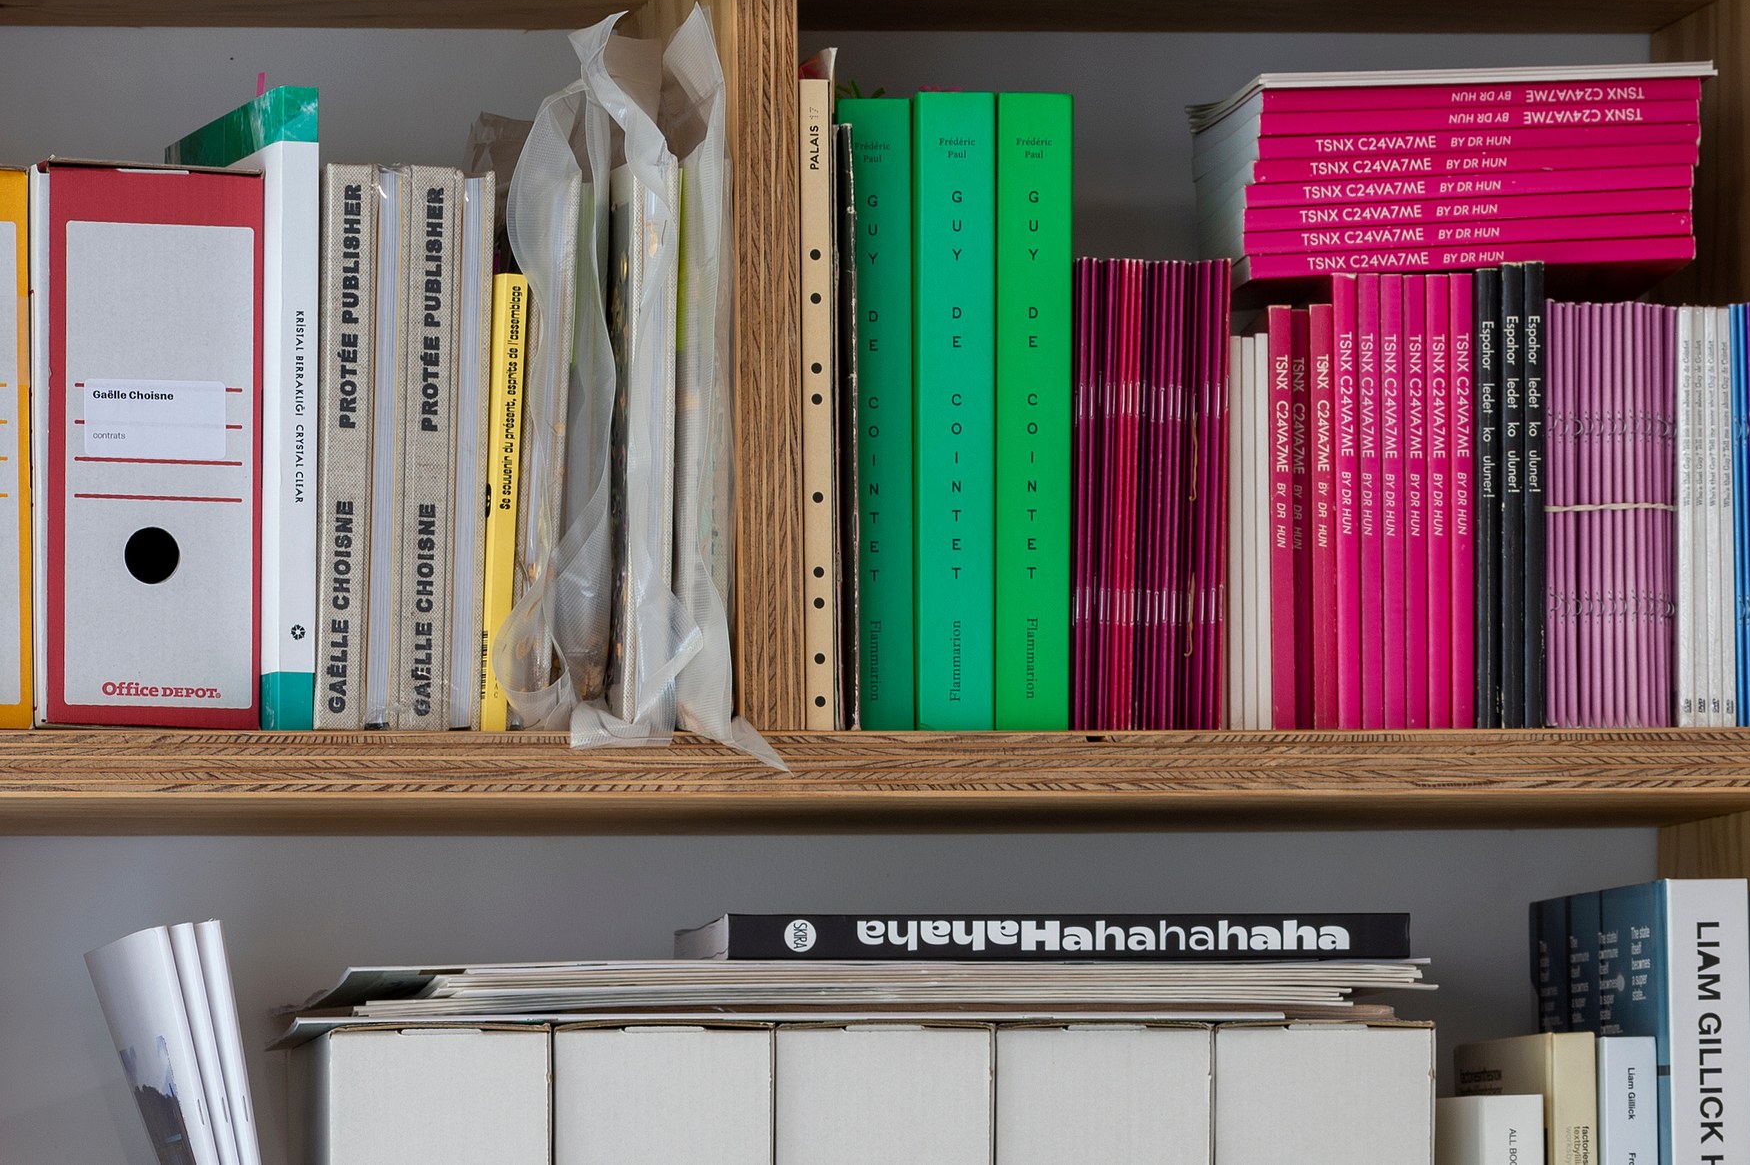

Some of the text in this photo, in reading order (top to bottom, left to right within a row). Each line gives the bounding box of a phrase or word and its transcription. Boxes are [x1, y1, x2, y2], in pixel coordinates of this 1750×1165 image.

[808, 124, 820, 171] PALAIS
[938, 137, 976, 147] Frédéric
[947, 150, 967, 159] Paul
[1315, 137, 1353, 152] TSNX
[1449, 137, 1467, 147] BY
[1468, 137, 1485, 146] DR
[1487, 134, 1511, 145] HUN
[337, 183, 362, 429] PROTÉE PUBLISHER
[1456, 332, 1469, 373] TSNX
[92, 388, 175, 401] Gaëlle Choisne
[1526, 315, 1541, 494] Espahor ledet ko uluner!
[92, 430, 126, 440] contrats
[294, 423, 305, 504] CRYSTAL CLEAR
[1459, 509, 1468, 535] HUN
[327, 500, 354, 714] GAËLLE CHOISNE
[949, 619, 962, 702] Flammarion
[1025, 617, 1038, 700] Flammarion
[102, 681, 159, 697] Office
[1696, 921, 1725, 1144] LIAM GILLICK
[1626, 1067, 1636, 1121] Liam Gillick
